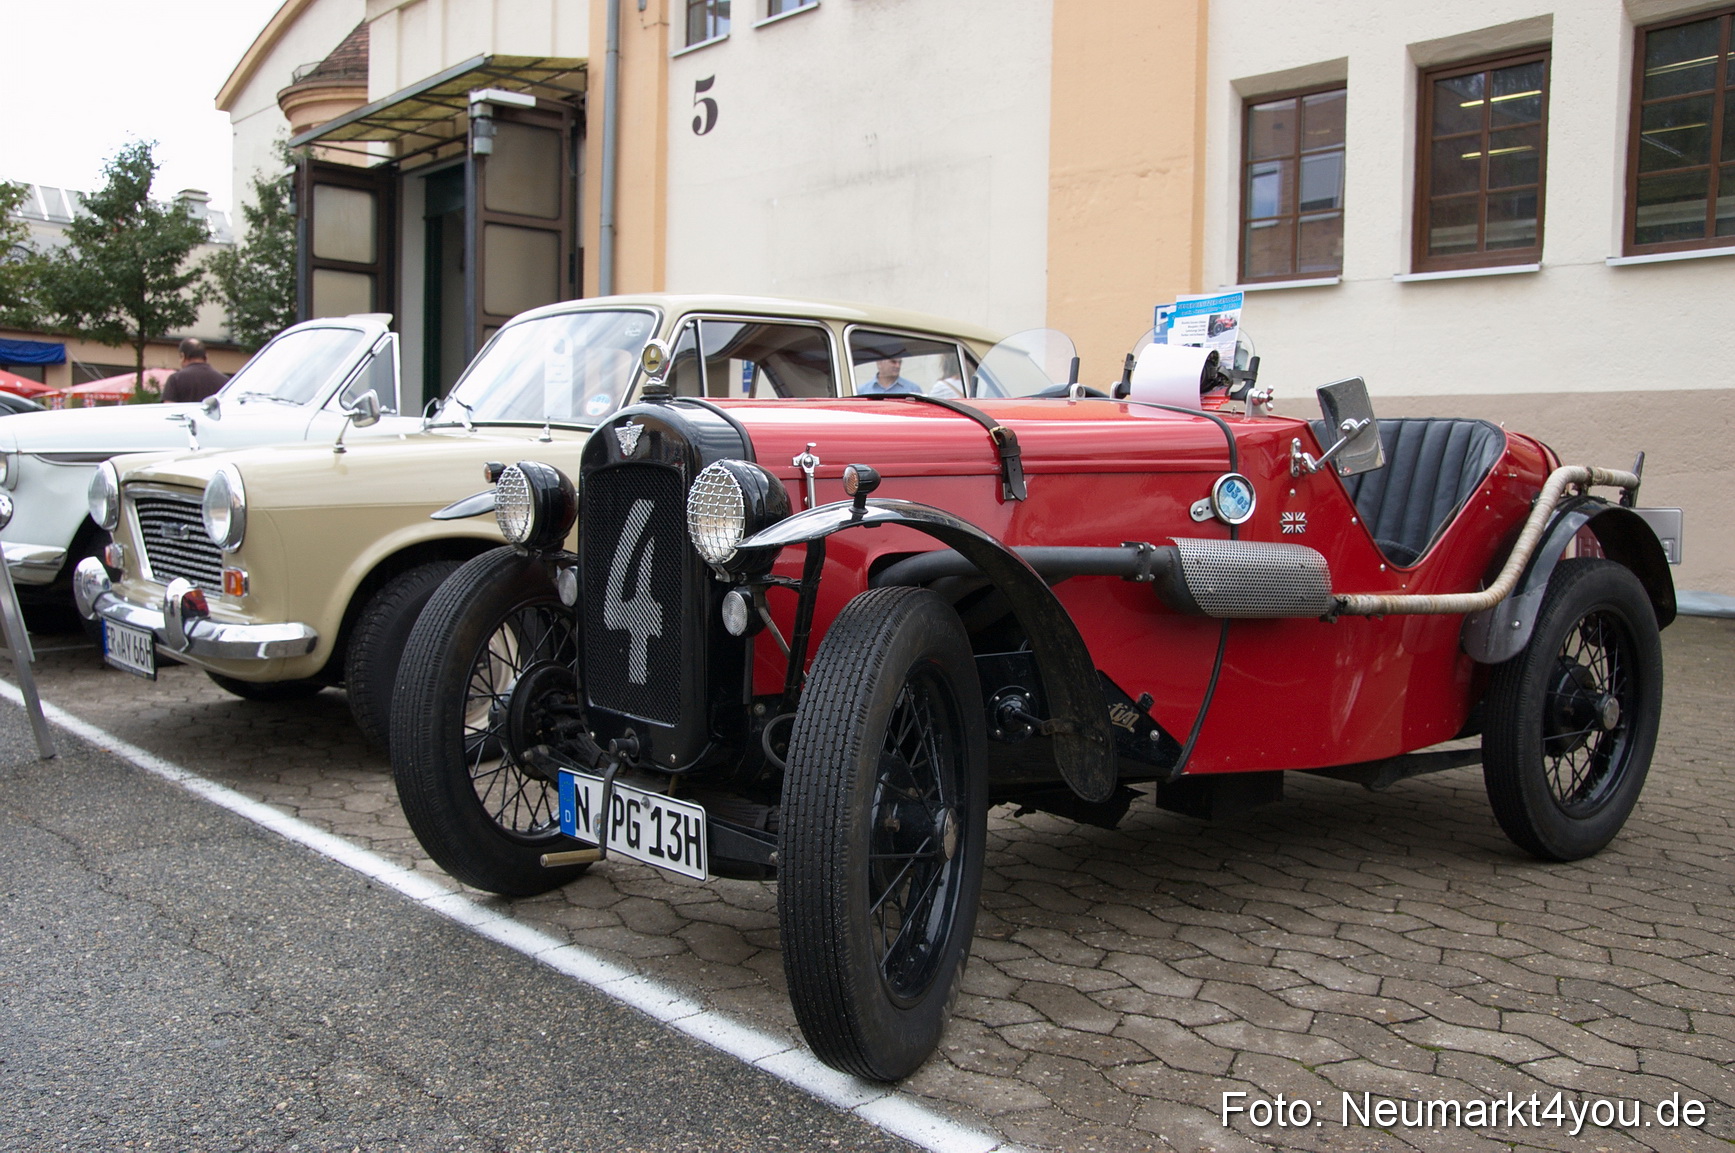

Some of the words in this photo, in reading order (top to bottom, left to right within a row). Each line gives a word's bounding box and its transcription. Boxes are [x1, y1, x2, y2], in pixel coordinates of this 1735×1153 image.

[692, 74, 718, 136] 5
[603, 498, 663, 686] 4
[565, 809, 571, 823] D
[575, 783, 590, 833] N
[611, 793, 641, 850] PG
[649, 805, 702, 870] 13H
